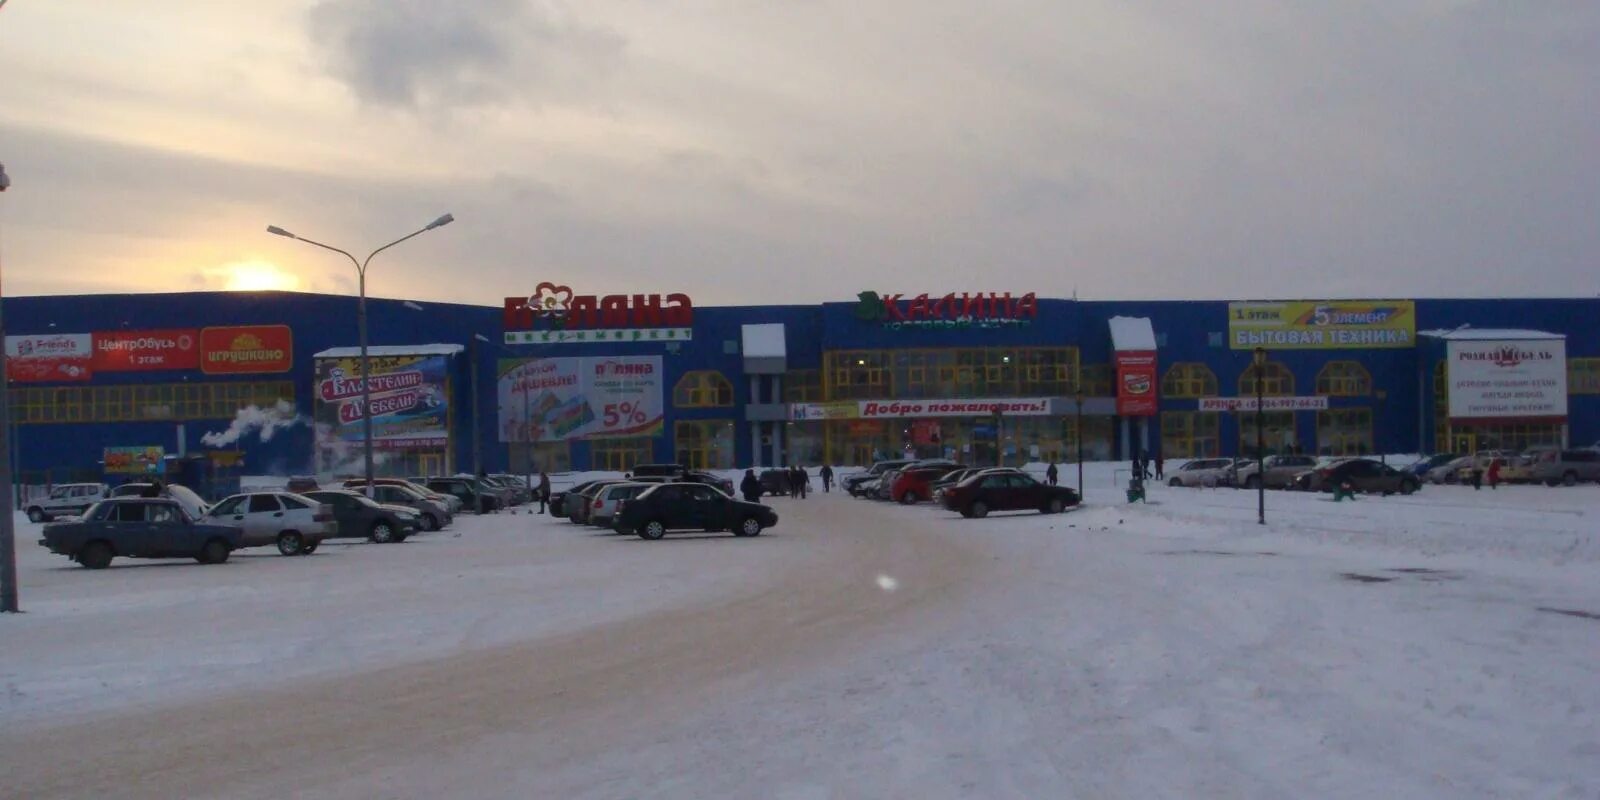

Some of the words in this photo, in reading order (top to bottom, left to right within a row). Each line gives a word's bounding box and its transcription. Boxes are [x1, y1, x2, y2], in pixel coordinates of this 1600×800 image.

[883, 292, 1036, 319] КАЛИНА
[1236, 309, 1244, 320] 1
[1247, 310, 1281, 321] этаж
[1315, 306, 1330, 326] 5
[1333, 312, 1388, 324] ЭЛЕМЕНТ
[1236, 330, 1323, 345] БЫТОВАЯ
[1329, 329, 1409, 343] ТЕХНИКА
[138, 355, 164, 365] этаж
[1459, 351, 1500, 361] РОДНАЯ
[603, 400, 648, 427] 5%
[863, 402, 923, 417] Добро
[927, 400, 1047, 414] пожаловать!
